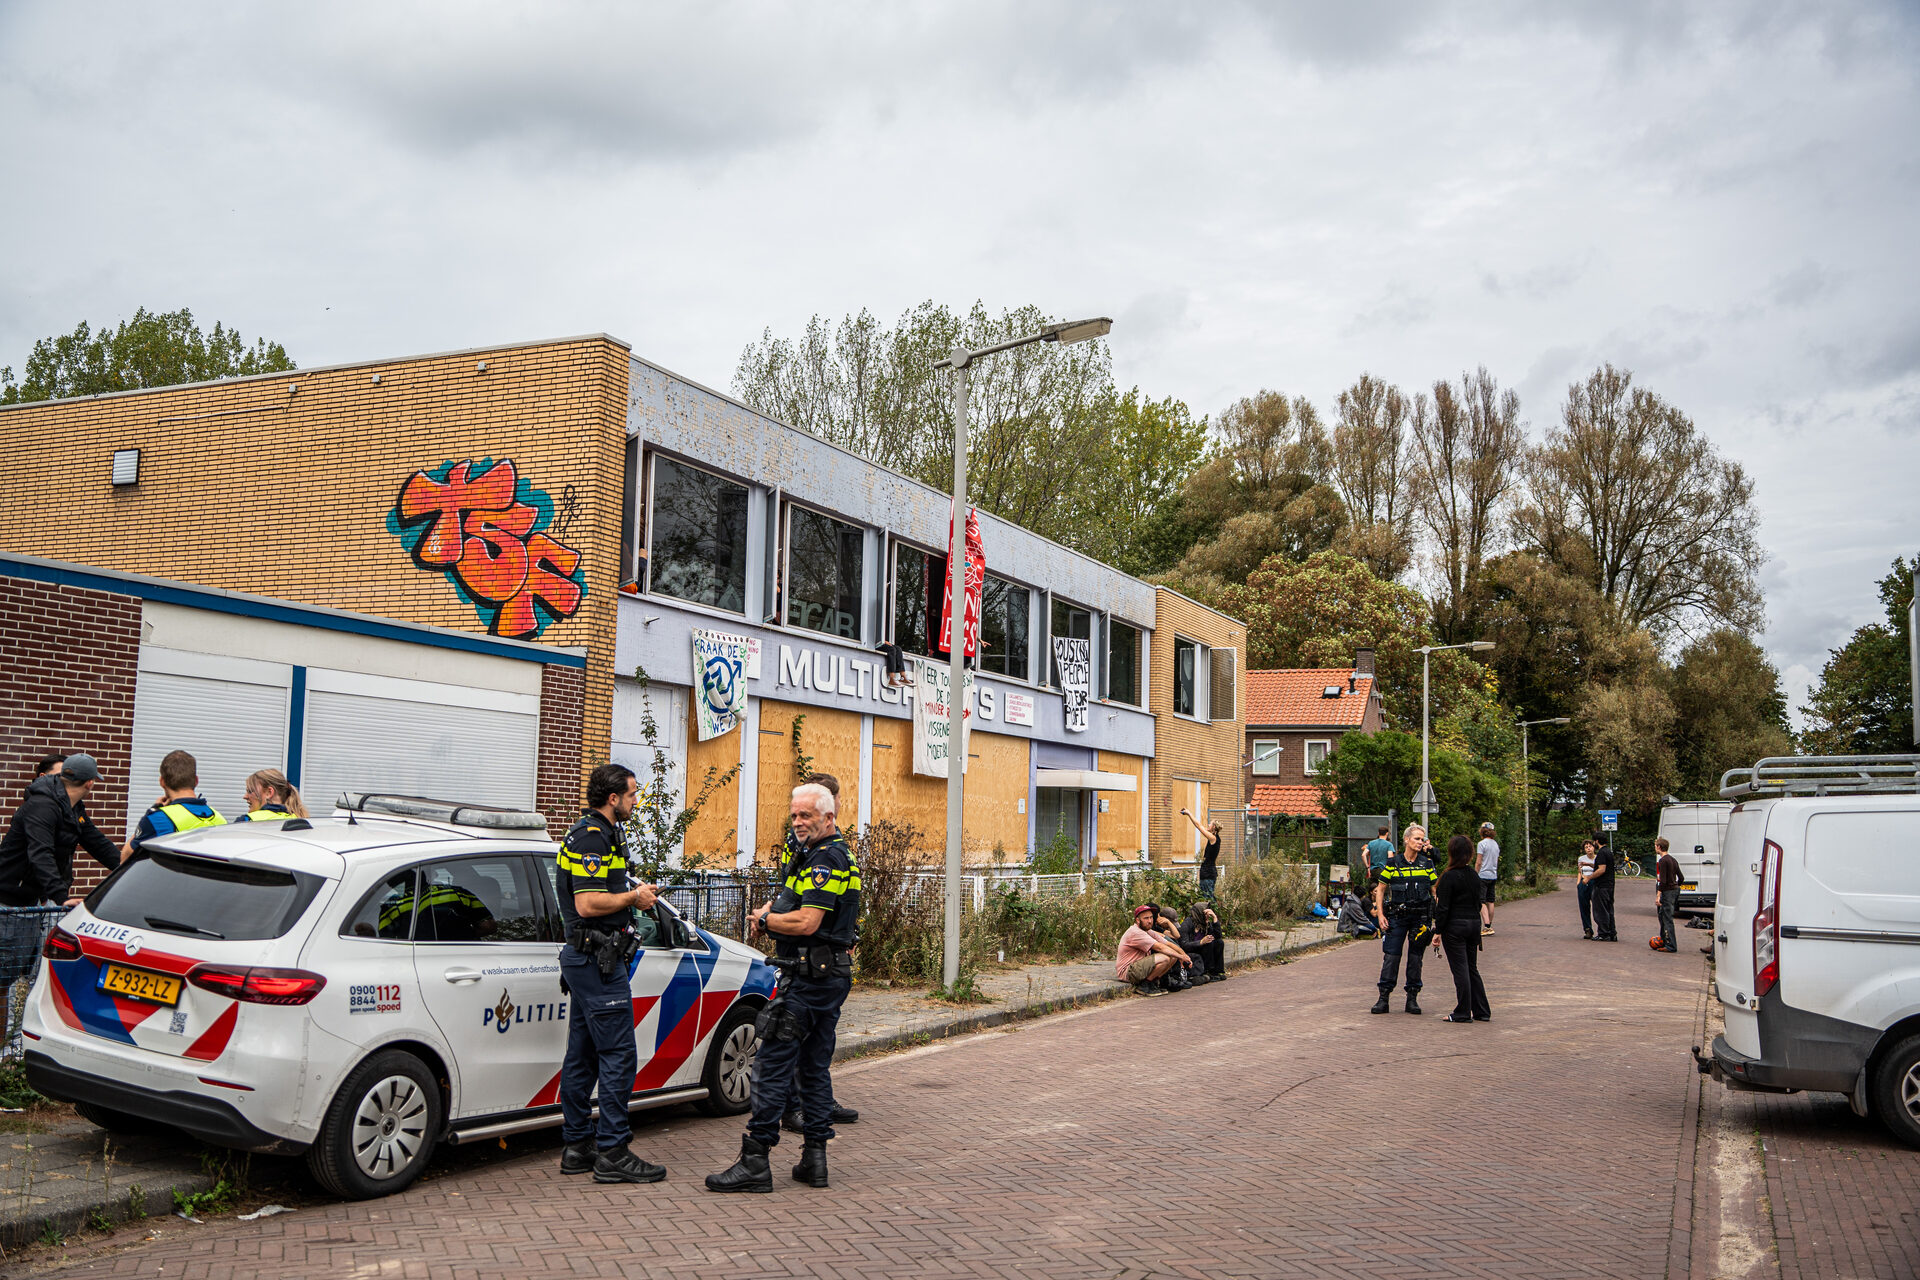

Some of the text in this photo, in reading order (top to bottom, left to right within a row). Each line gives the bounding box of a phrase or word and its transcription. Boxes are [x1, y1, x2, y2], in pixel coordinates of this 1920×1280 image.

[728, 645, 739, 658] DE
[779, 644, 995, 720] MULTISPS
[76, 922, 129, 940] POLITIE
[487, 967, 520, 975] waakzaam
[529, 965, 559, 973] dienstbaar
[109, 969, 171, 999] Z-932-LZ
[350, 985, 375, 995] 0900
[376, 985, 400, 1001] 112
[350, 996, 375, 1006] 8844
[377, 1002, 400, 1013] spoed
[483, 1003, 567, 1034] POLITIE
